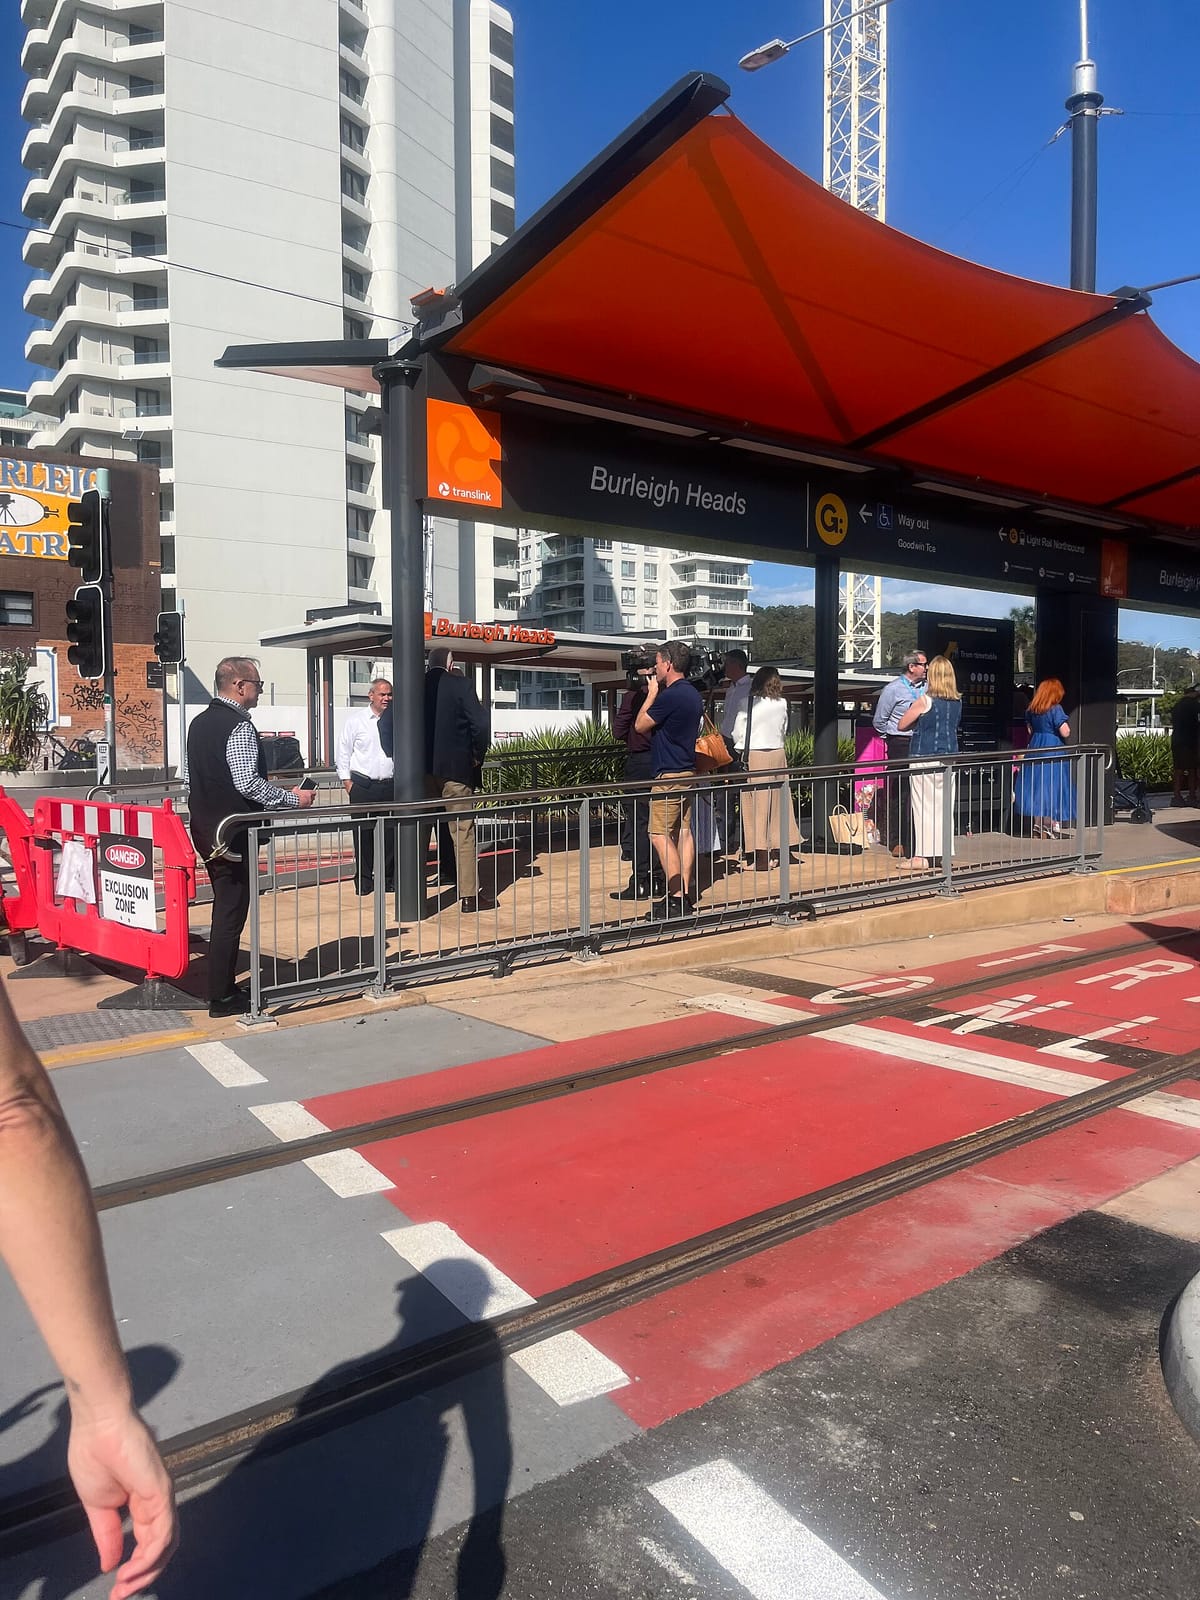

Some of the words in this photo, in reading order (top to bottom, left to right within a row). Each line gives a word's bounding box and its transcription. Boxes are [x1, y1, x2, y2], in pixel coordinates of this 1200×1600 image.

[452, 486, 492, 501] translink
[590, 465, 680, 507] Burleigh
[685, 483, 747, 515] Heads
[897, 513, 915, 530] Way
[916, 519, 930, 530] out
[0, 531, 68, 556] ATR
[897, 538, 925, 552] Goodwin
[926, 543, 937, 553] Tce
[1026, 535, 1041, 547] Light
[1041, 537, 1053, 547] Rail
[435, 617, 505, 645] Burleigh
[507, 623, 556, 645] Heads
[110, 848, 139, 865] DANGER
[105, 878, 149, 901] EXCLUSION
[115, 897, 136, 914] ZONE
